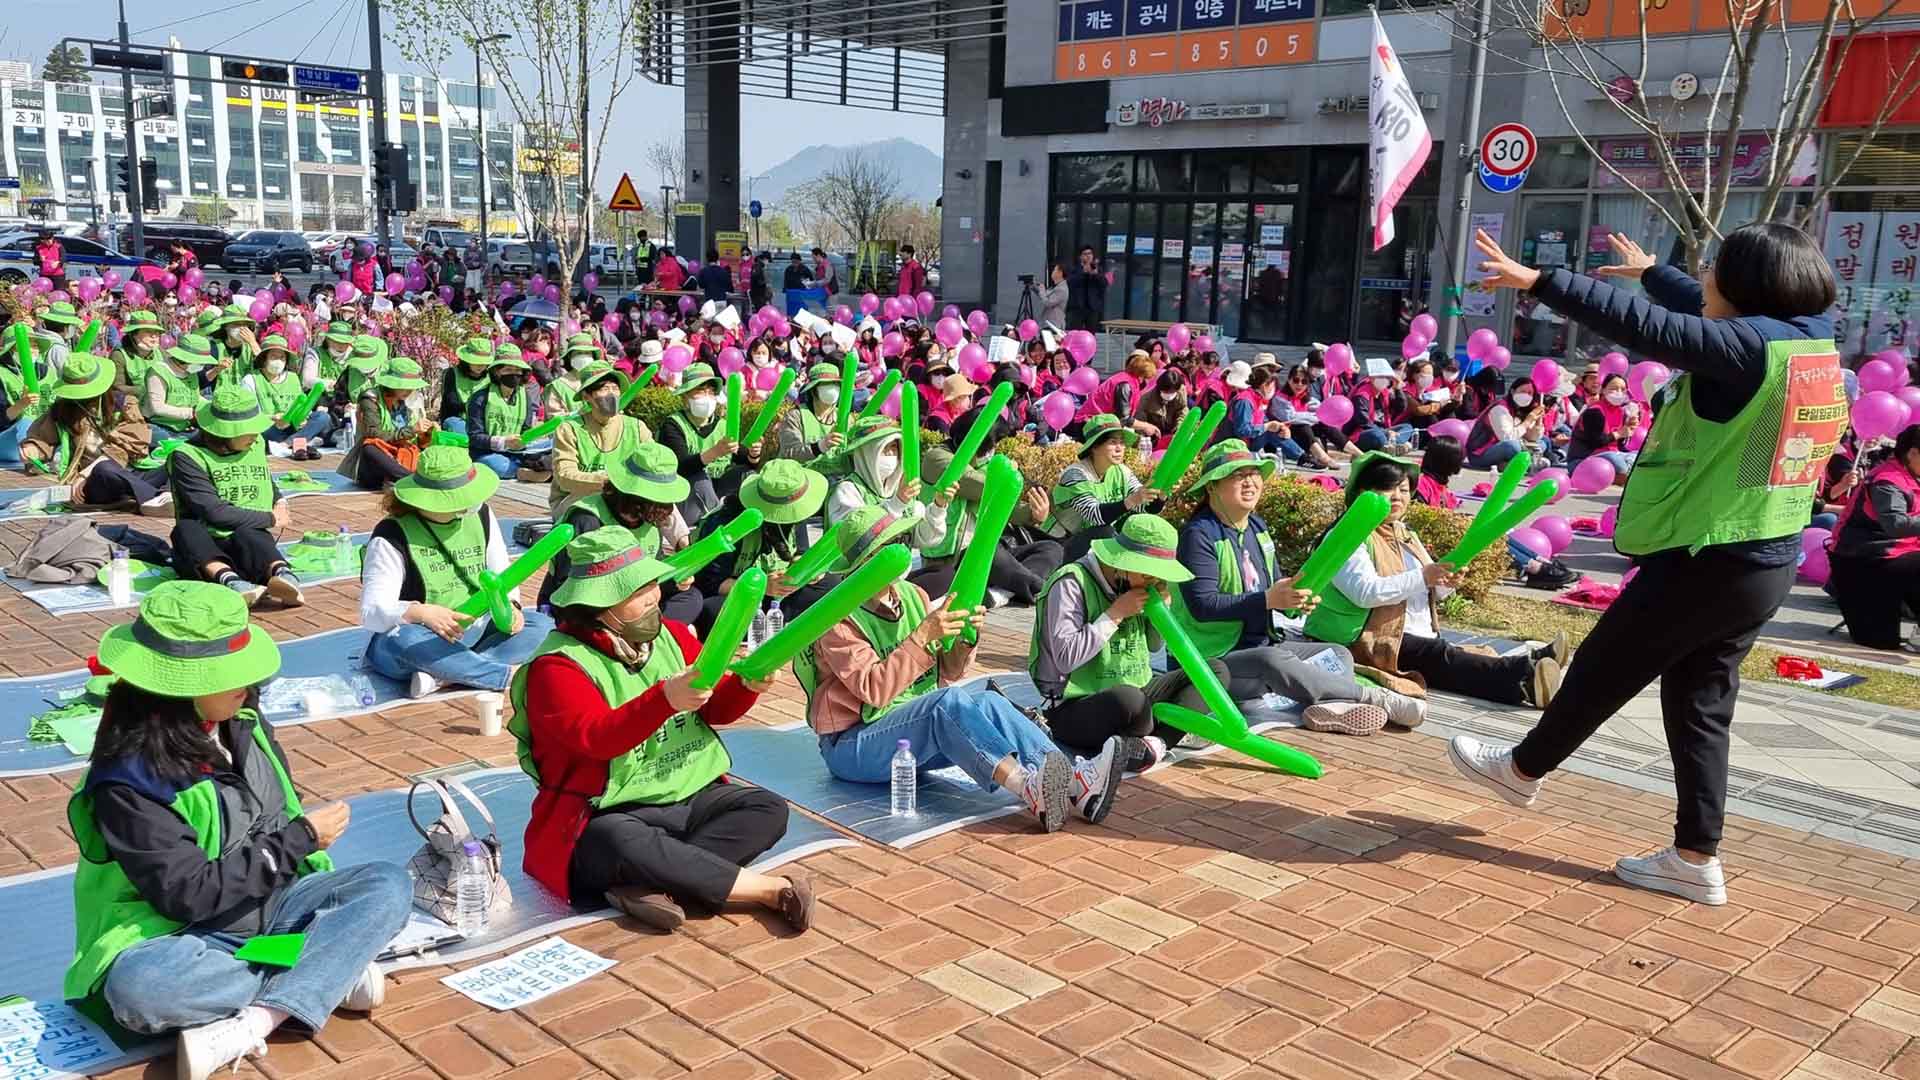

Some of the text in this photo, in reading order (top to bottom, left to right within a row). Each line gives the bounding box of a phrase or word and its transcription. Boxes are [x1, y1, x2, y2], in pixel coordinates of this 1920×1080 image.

[1085, 10, 1113, 30] 캐논
[1139, 3, 1168, 25] 공식
[1195, 0, 1225, 20] 인증
[15, 111, 42, 125] 조개
[63, 114, 89, 128] 구이
[1140, 98, 1185, 128] 명가
[1493, 139, 1525, 162] 30
